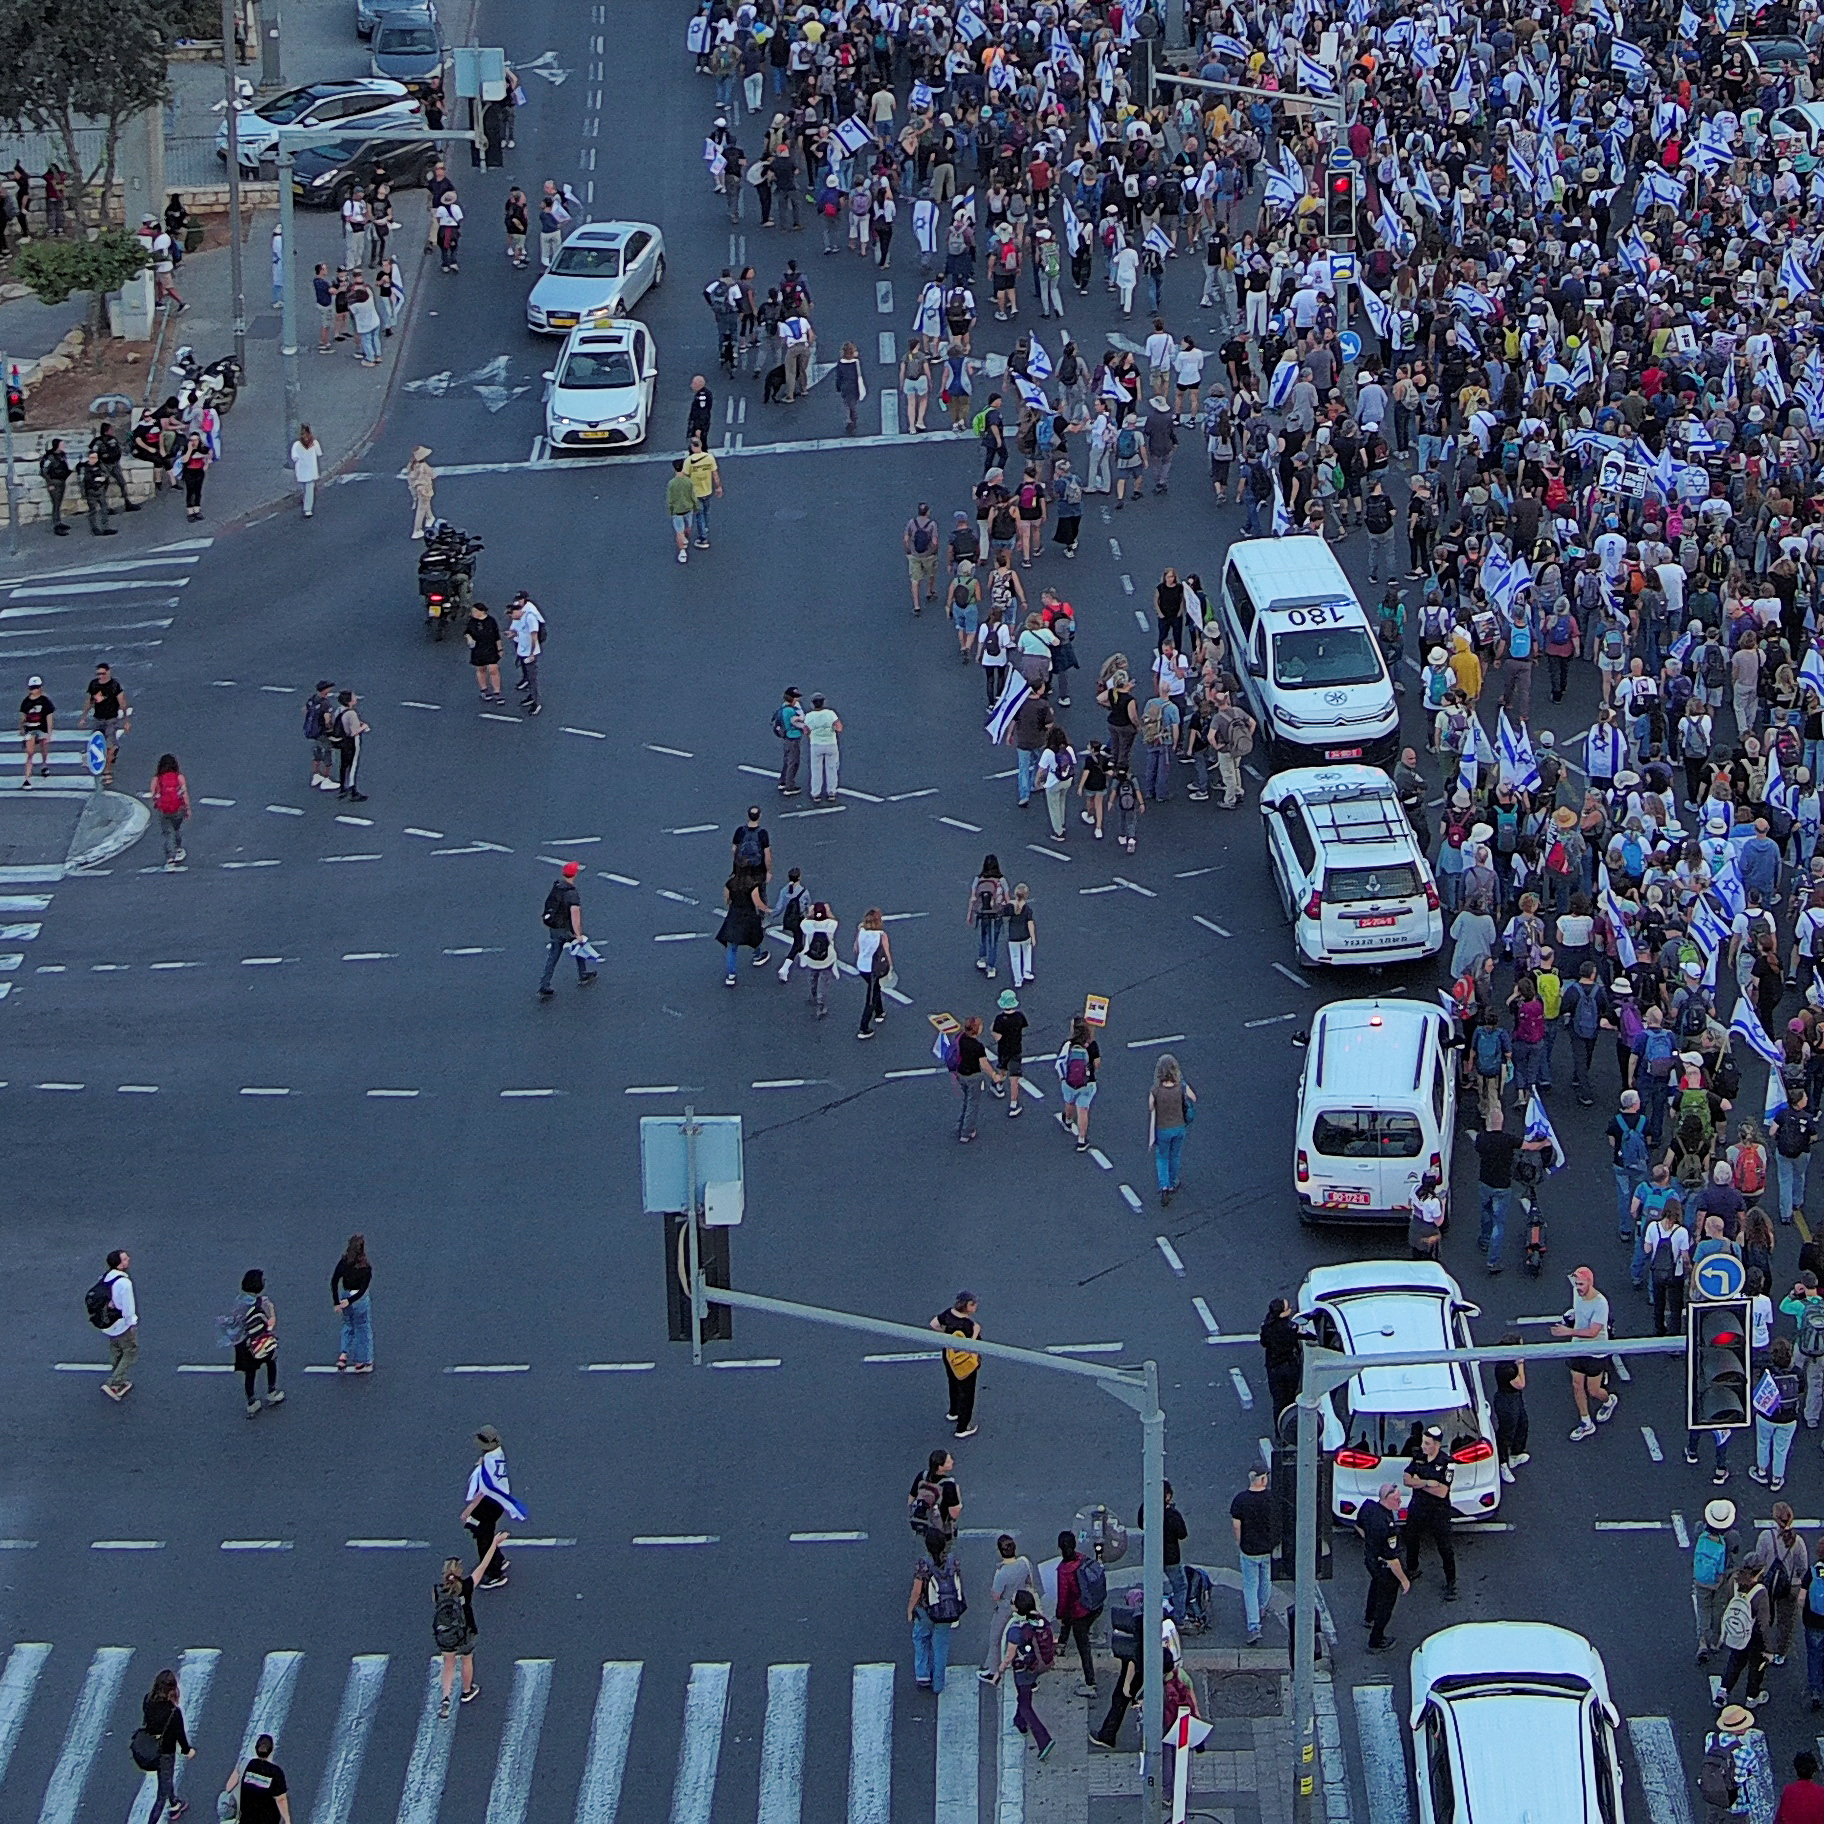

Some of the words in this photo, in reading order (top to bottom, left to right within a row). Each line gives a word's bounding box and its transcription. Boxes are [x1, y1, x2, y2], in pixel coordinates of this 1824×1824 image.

[1288, 606, 1345, 626] 180
[1344, 938, 1374, 946] הגבול
[1379, 936, 1408, 945] משמר
